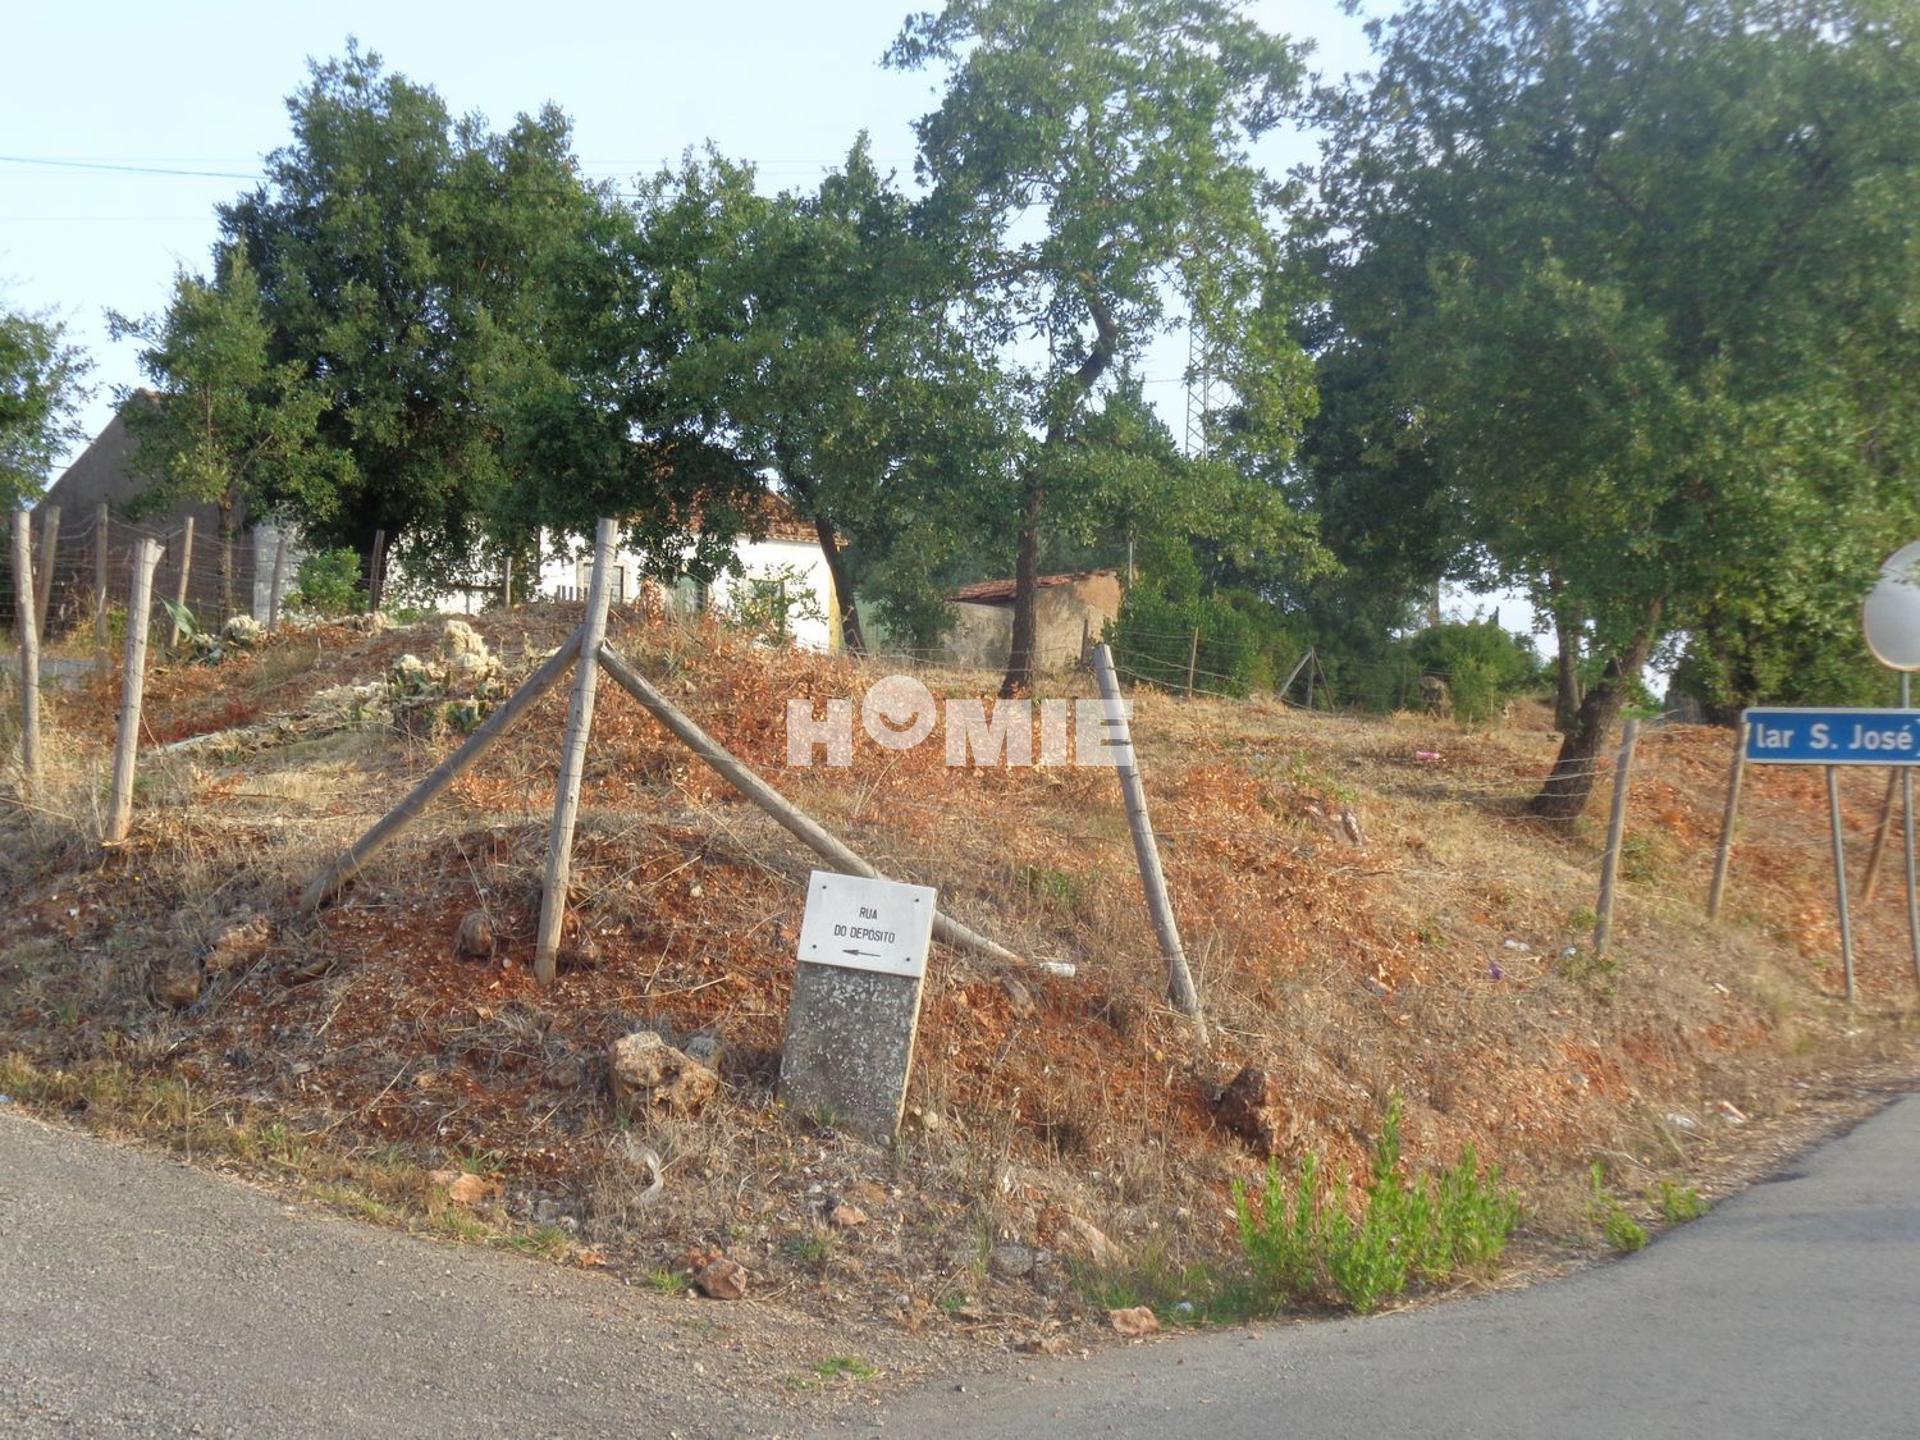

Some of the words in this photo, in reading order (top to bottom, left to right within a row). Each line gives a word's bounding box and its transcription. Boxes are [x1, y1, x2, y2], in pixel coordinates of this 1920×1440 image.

[1756, 723, 1795, 749] lar
[1809, 723, 1838, 749] S.
[1848, 724, 1913, 750] José
[859, 906, 878, 920] RUA
[834, 924, 847, 937] DO
